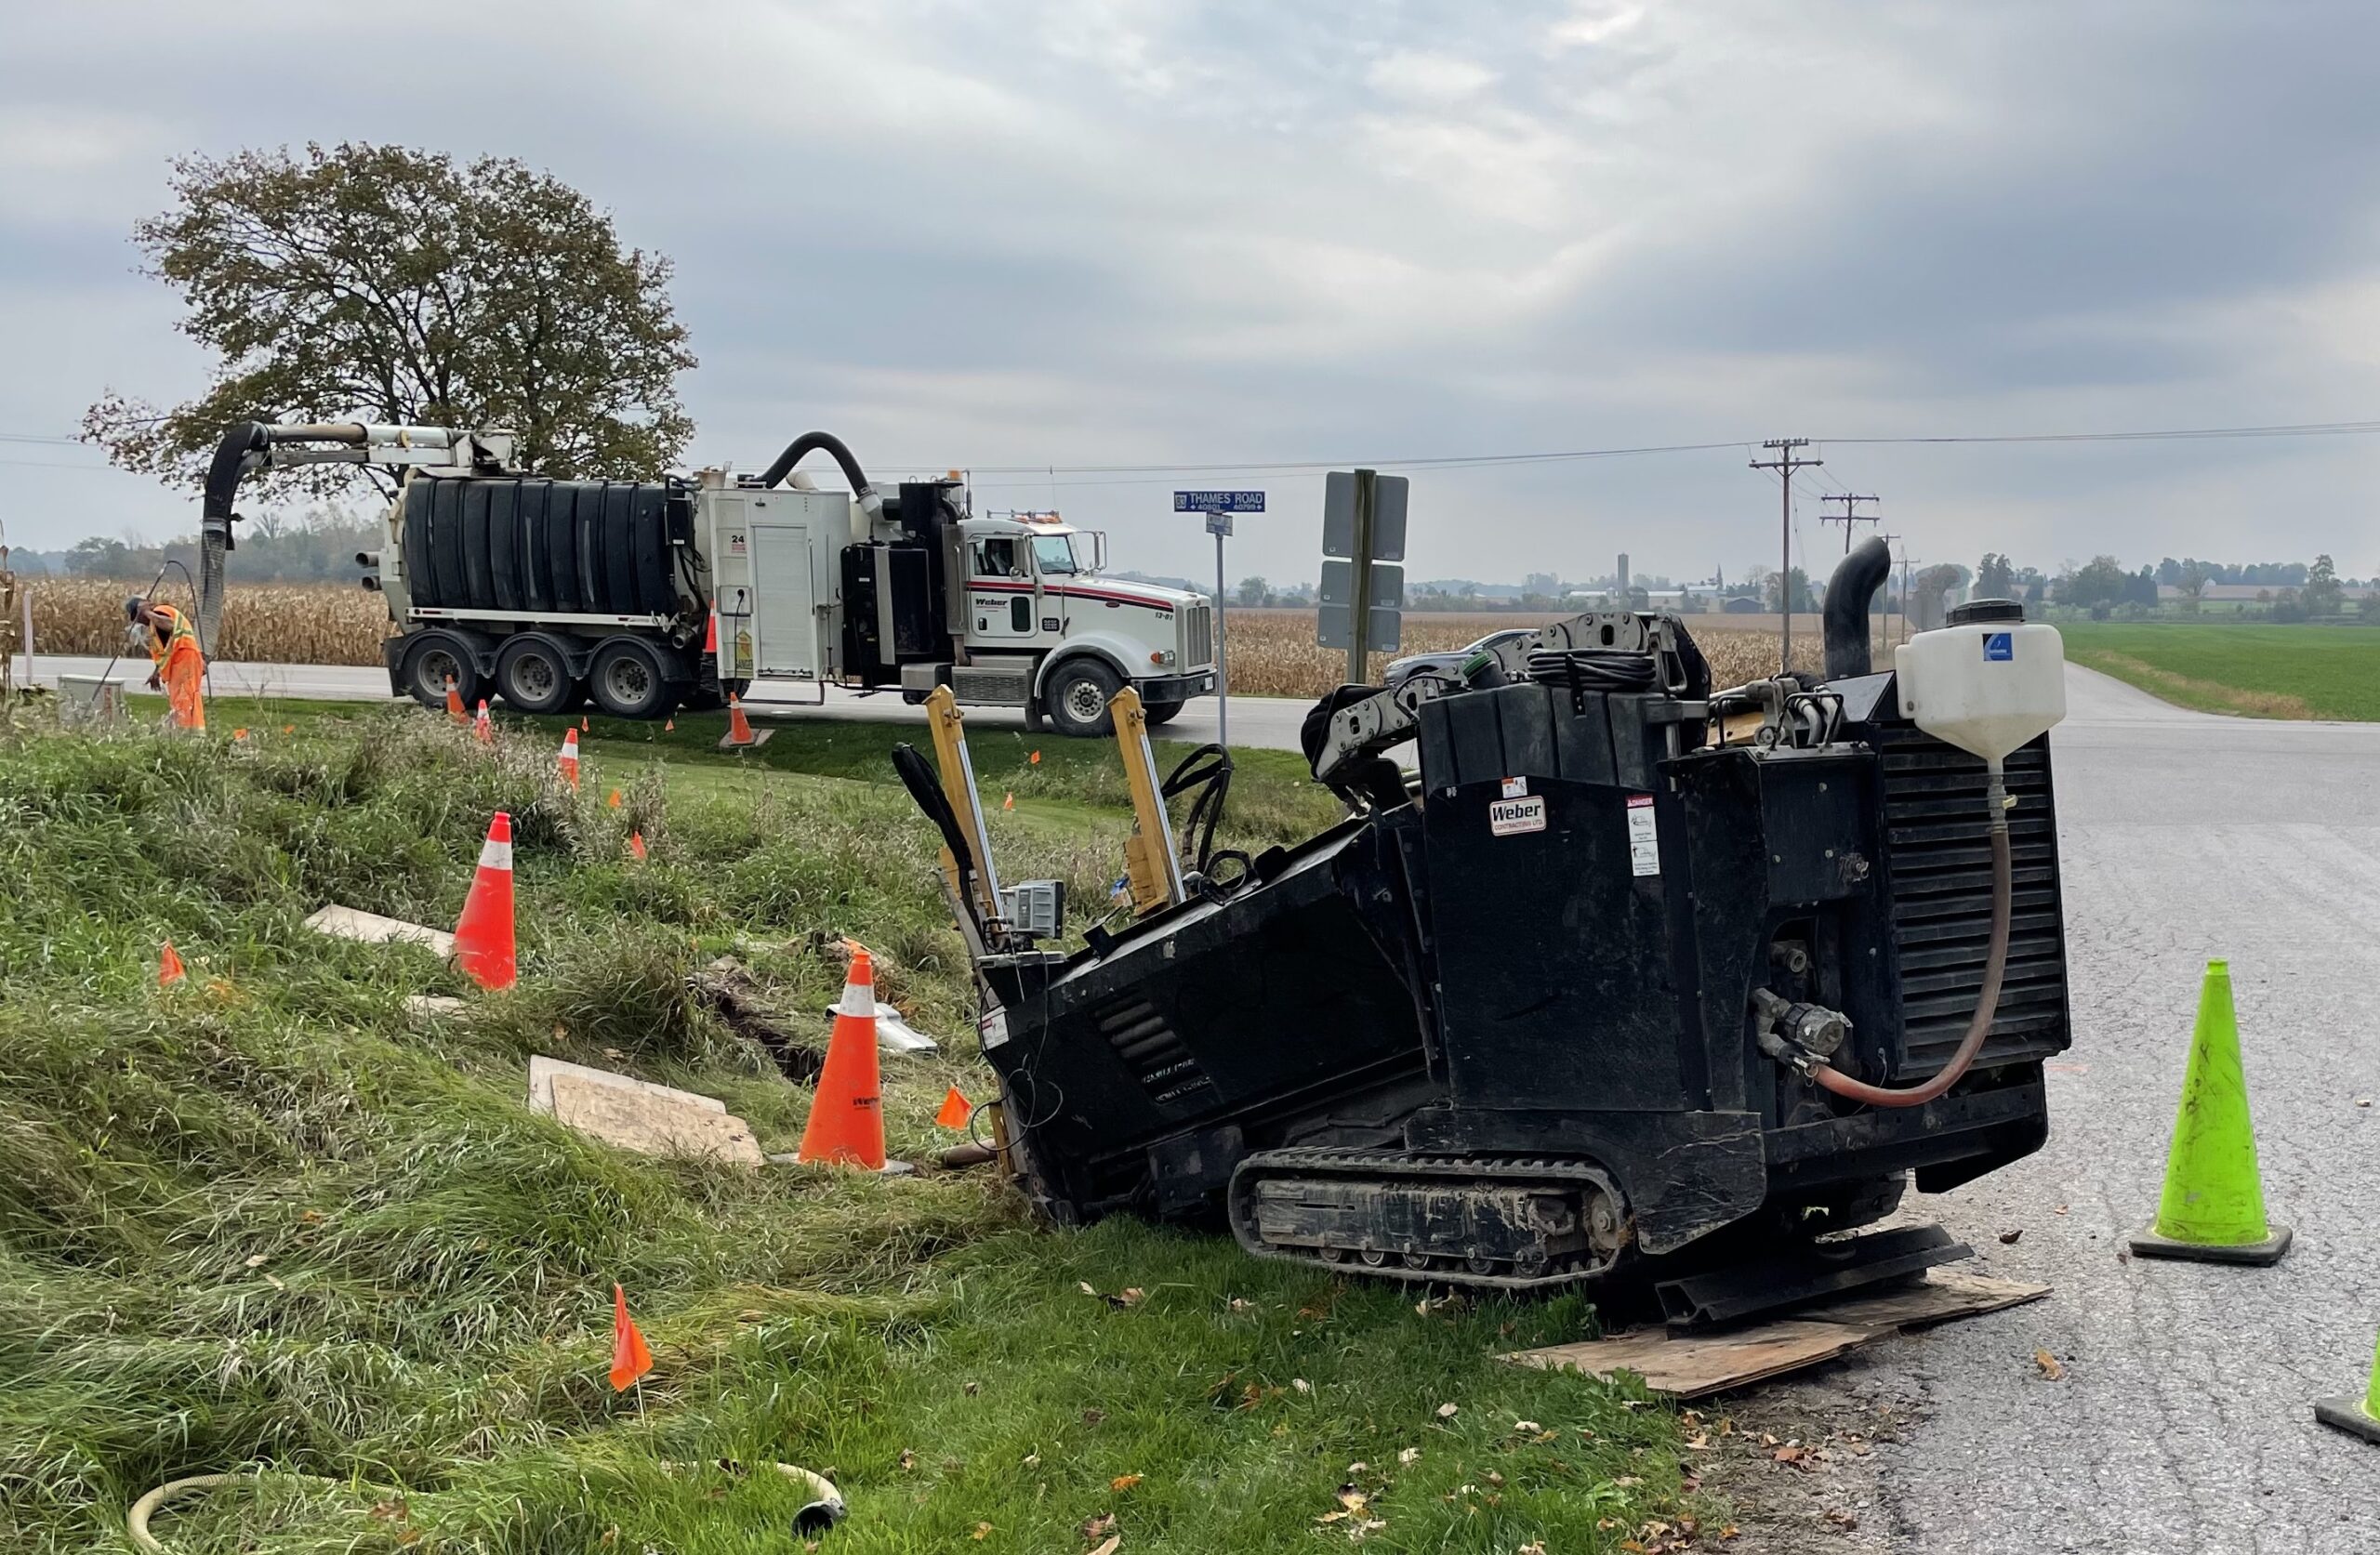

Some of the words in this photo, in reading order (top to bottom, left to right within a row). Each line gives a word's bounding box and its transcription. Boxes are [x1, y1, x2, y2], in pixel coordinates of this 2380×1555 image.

[1190, 493, 1231, 504] THAMES
[1235, 493, 1263, 504] ROAD
[732, 534, 745, 543] 24
[975, 598, 1008, 606] Weber
[1492, 804, 1541, 822] Weber
